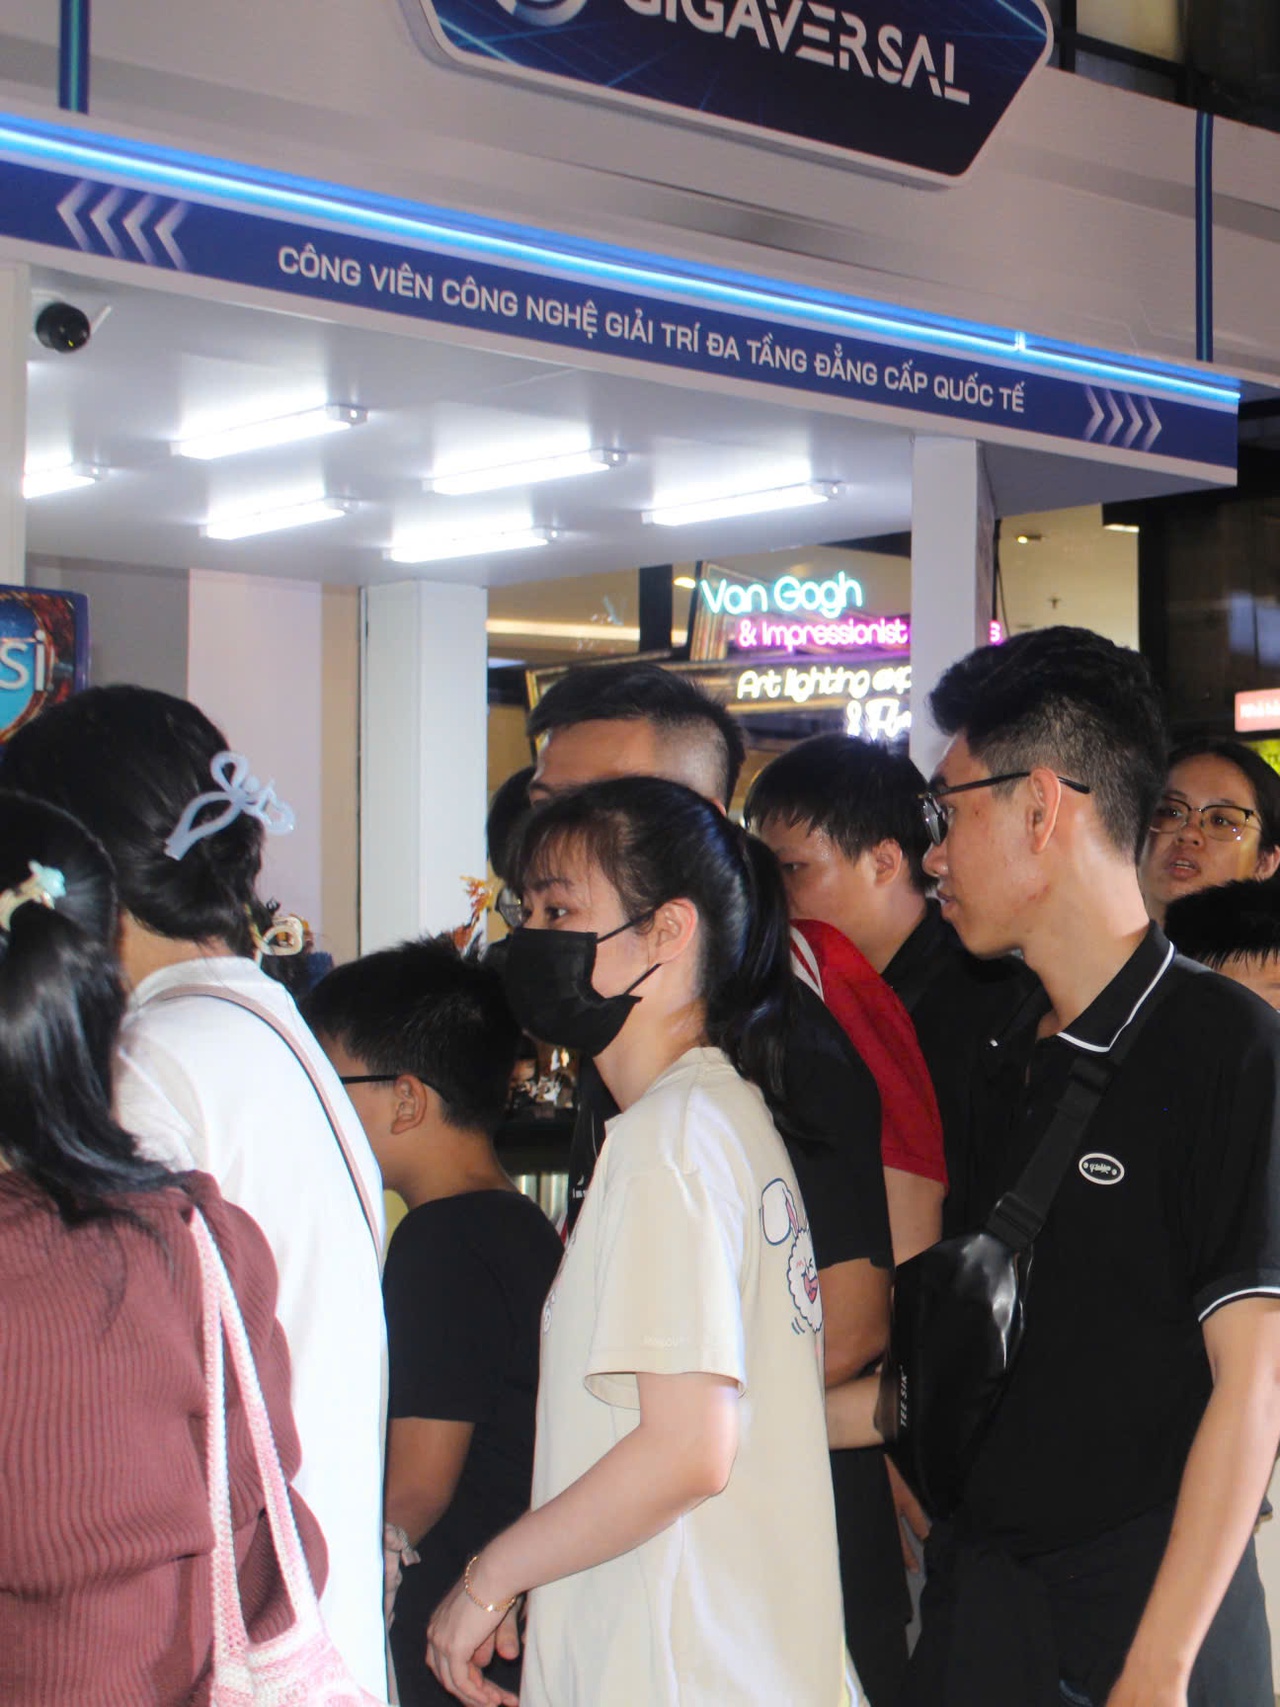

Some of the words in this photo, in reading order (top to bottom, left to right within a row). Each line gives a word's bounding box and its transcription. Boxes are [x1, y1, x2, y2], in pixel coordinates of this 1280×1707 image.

[279, 243, 361, 287] CÔNG
[369, 263, 433, 301] VIÊN
[442, 276, 518, 317] CÔNG
[526, 295, 598, 339] NGHỆ
[605, 308, 654, 344] GIẢI
[661, 321, 699, 352] TRÍ
[707, 337, 740, 361] ĐA
[747, 333, 807, 373] TẦNG
[814, 344, 878, 386] ĐẲNG
[884, 359, 928, 393] CẤP
[934, 372, 994, 407] QUỐC
[999, 381, 1025, 413] TẾ
[701, 578, 768, 614] Van
[774, 571, 863, 619] Gogh
[739, 619, 757, 647] &
[762, 618, 909, 653] Impressionist
[737, 668, 782, 699] Art
